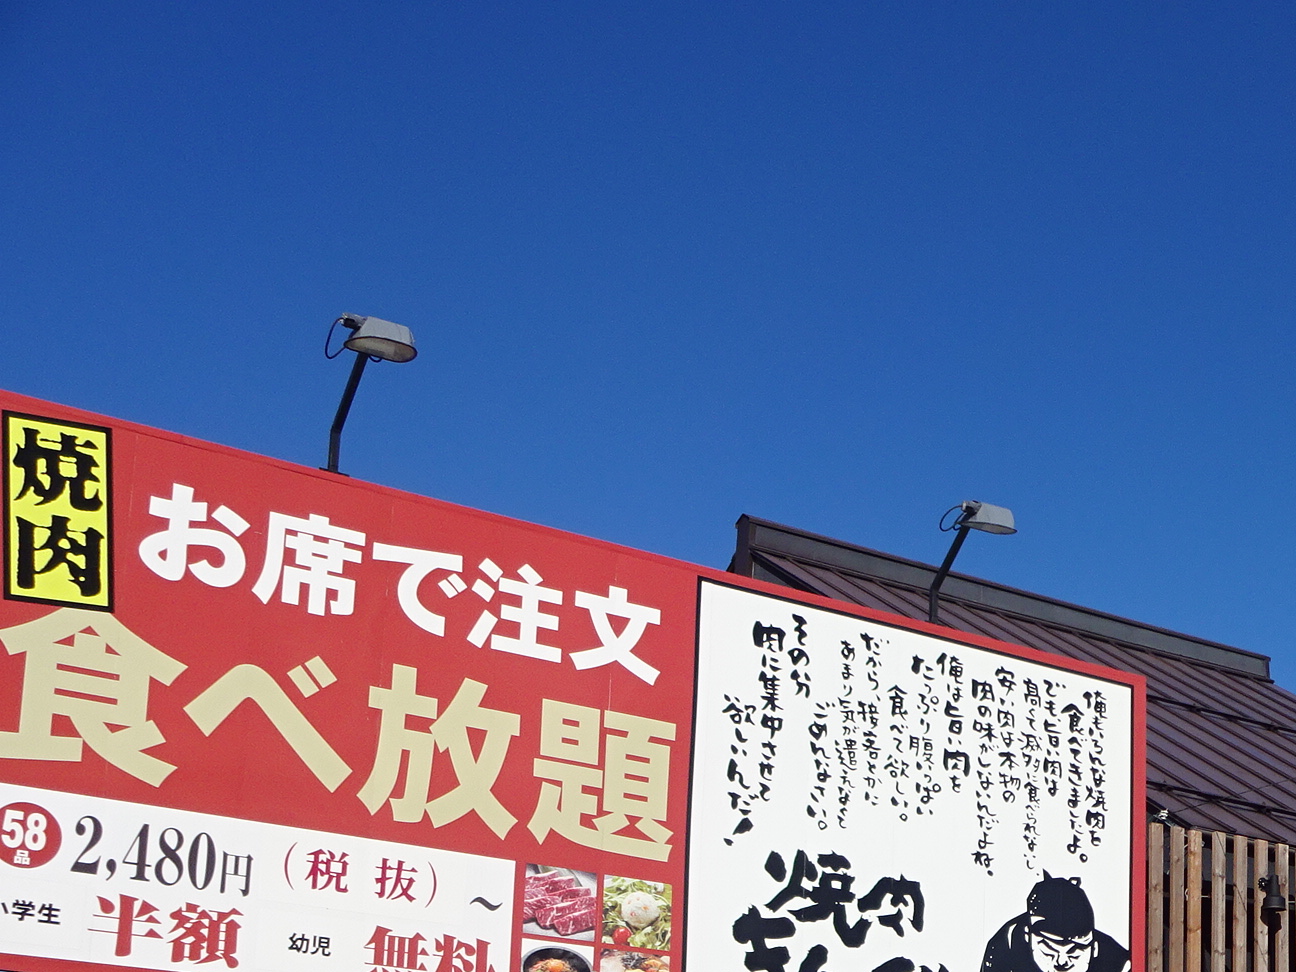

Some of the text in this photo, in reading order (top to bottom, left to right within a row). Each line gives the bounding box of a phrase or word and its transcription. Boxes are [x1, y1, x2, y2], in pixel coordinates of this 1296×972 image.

[12, 427, 104, 598] 焼肉
[138, 482, 662, 686] お席で注文
[752, 620, 787, 802] 肉に集中させて
[788, 613, 812, 698] その分
[936, 652, 970, 794] 俺は旨い肉を
[0, 607, 677, 863] 食べ放題
[884, 685, 910, 822] 食べて欲しい。
[909, 654, 942, 816] たっぷり腹いっぱい
[995, 666, 1022, 804] 安い肉は本物の
[1083, 690, 1108, 847] 俺もいろんな焼肉を
[1, 809, 47, 851] 58
[13, 850, 31, 866] 品
[764, 850, 926, 948] 焼肉
[87, 893, 244, 970] 半額
[288, 932, 332, 958] 幼児
